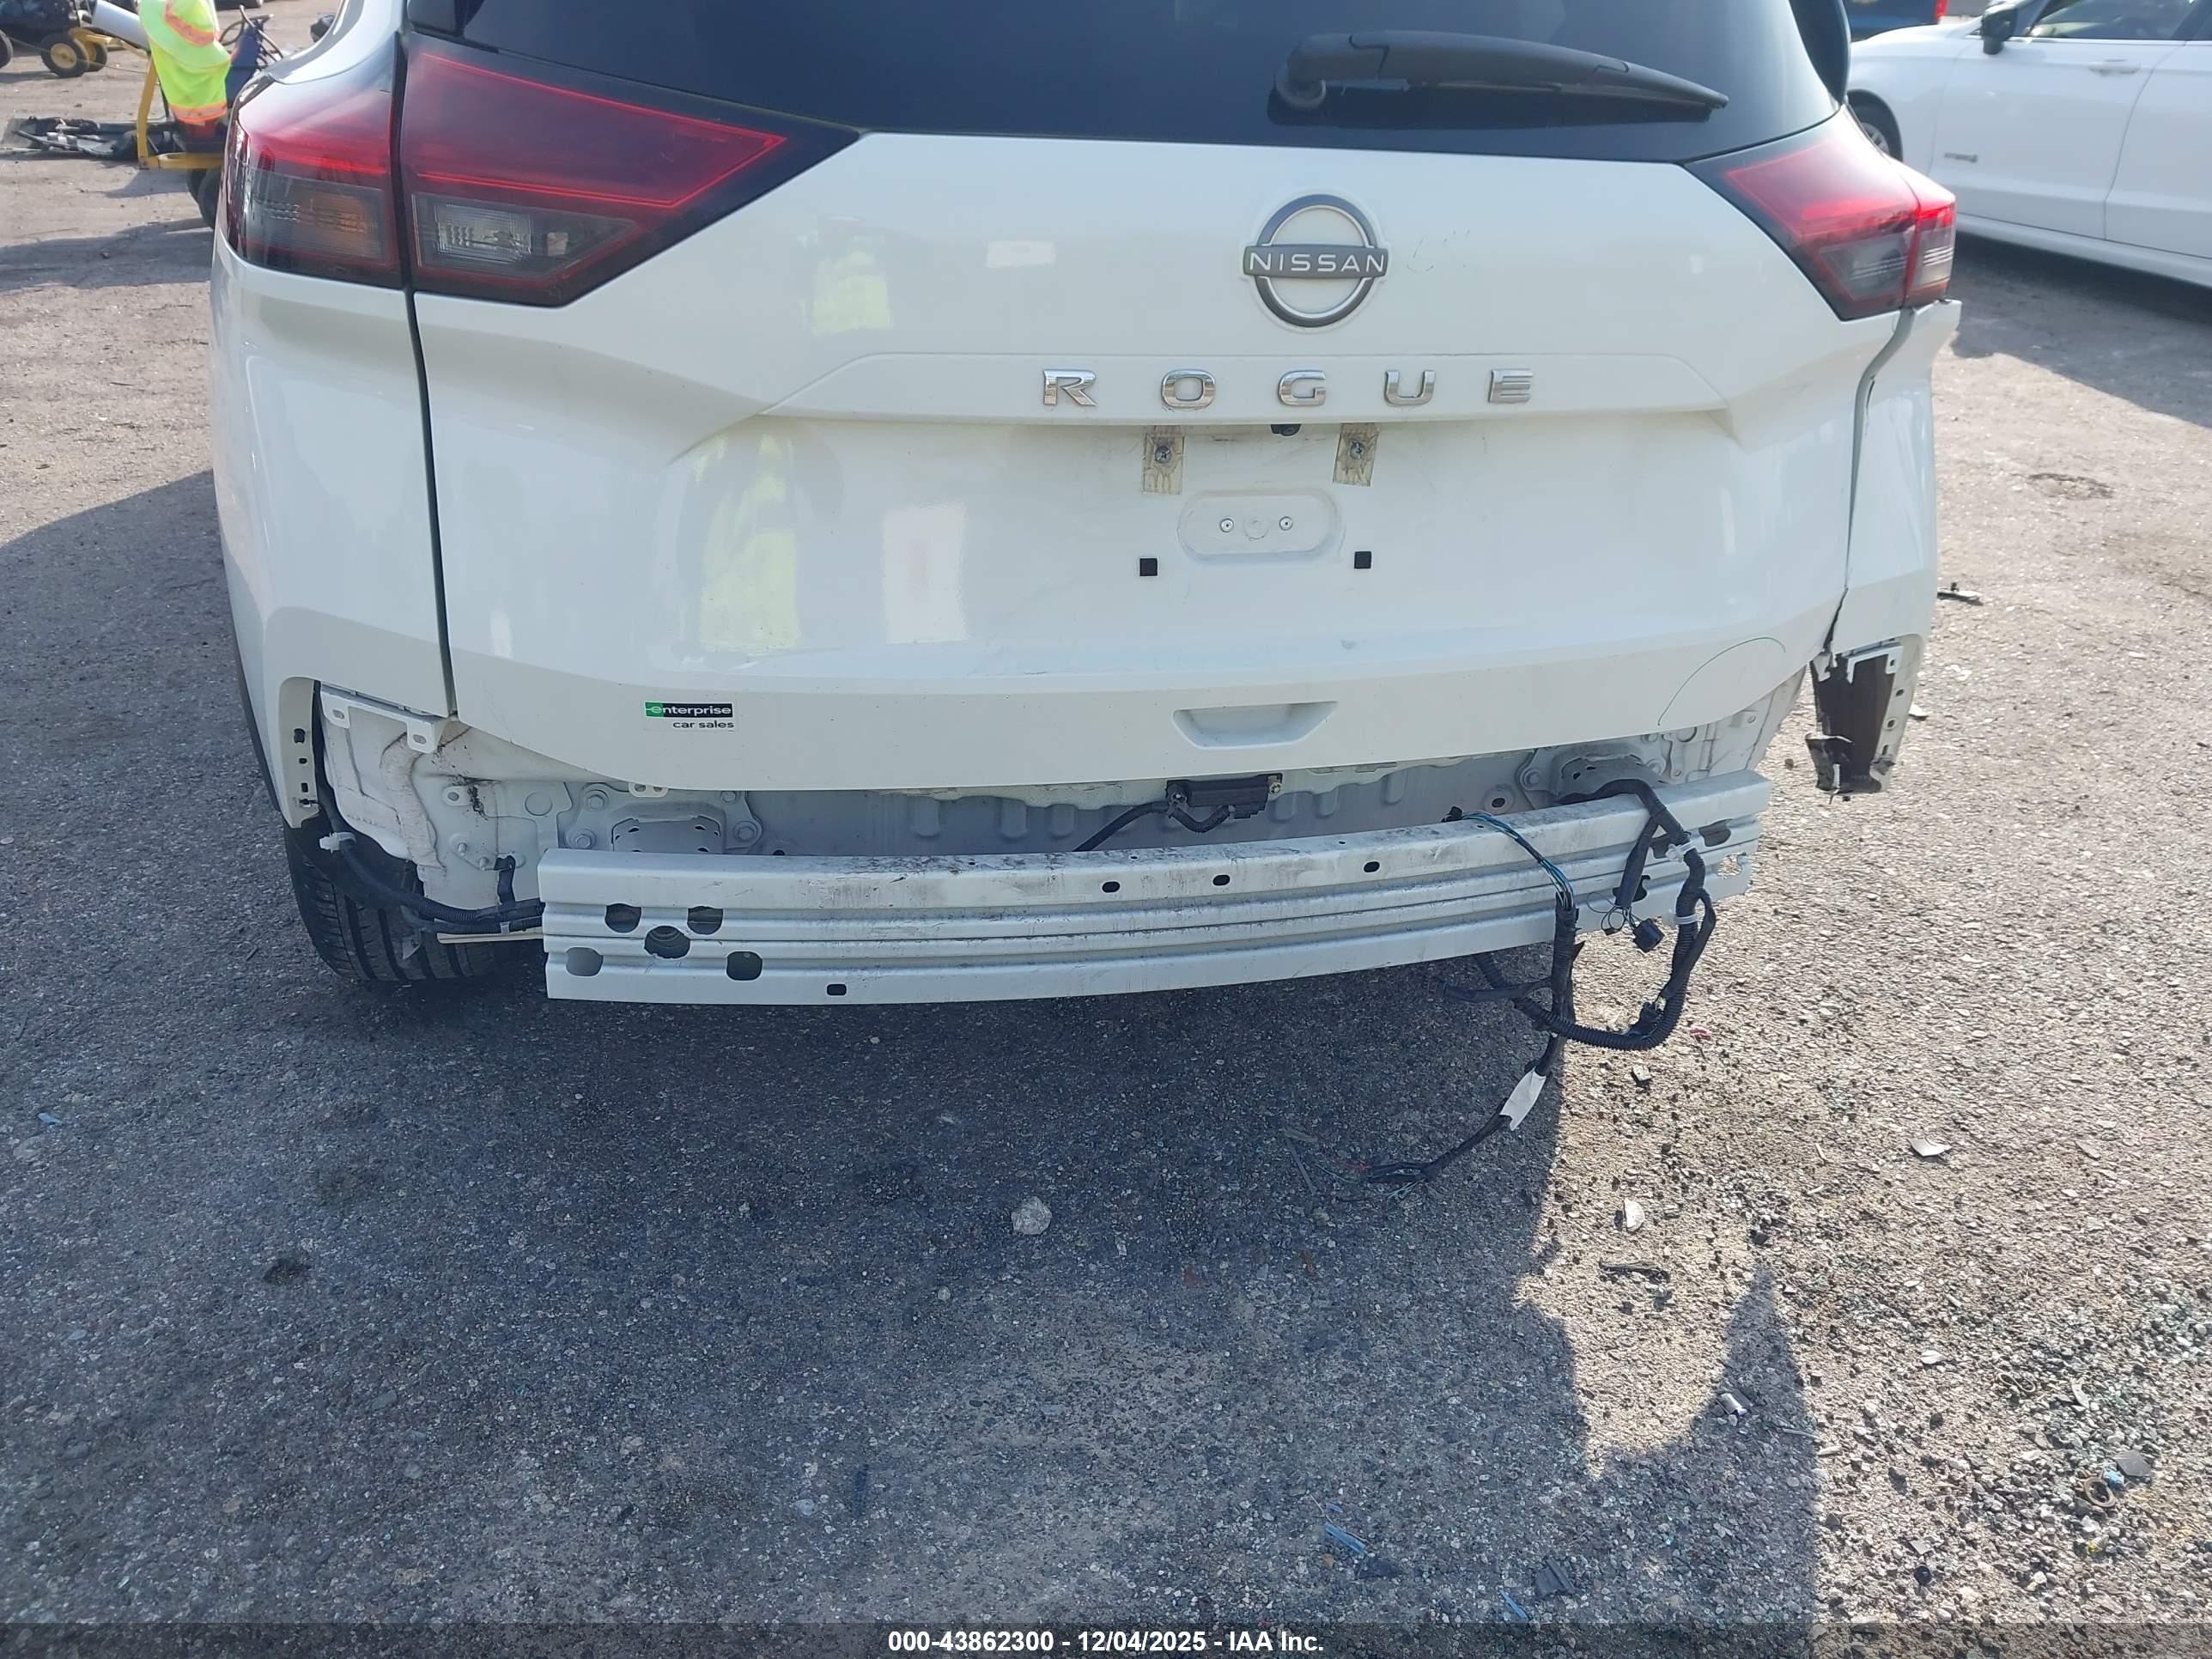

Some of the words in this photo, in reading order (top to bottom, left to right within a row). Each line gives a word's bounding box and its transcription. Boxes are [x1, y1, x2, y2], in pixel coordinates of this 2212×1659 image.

[1249, 252, 1385, 273] NISSAN
[1042, 368, 1534, 409] ROGUE
[646, 705, 732, 716] enterprise
[698, 720, 735, 729] sales
